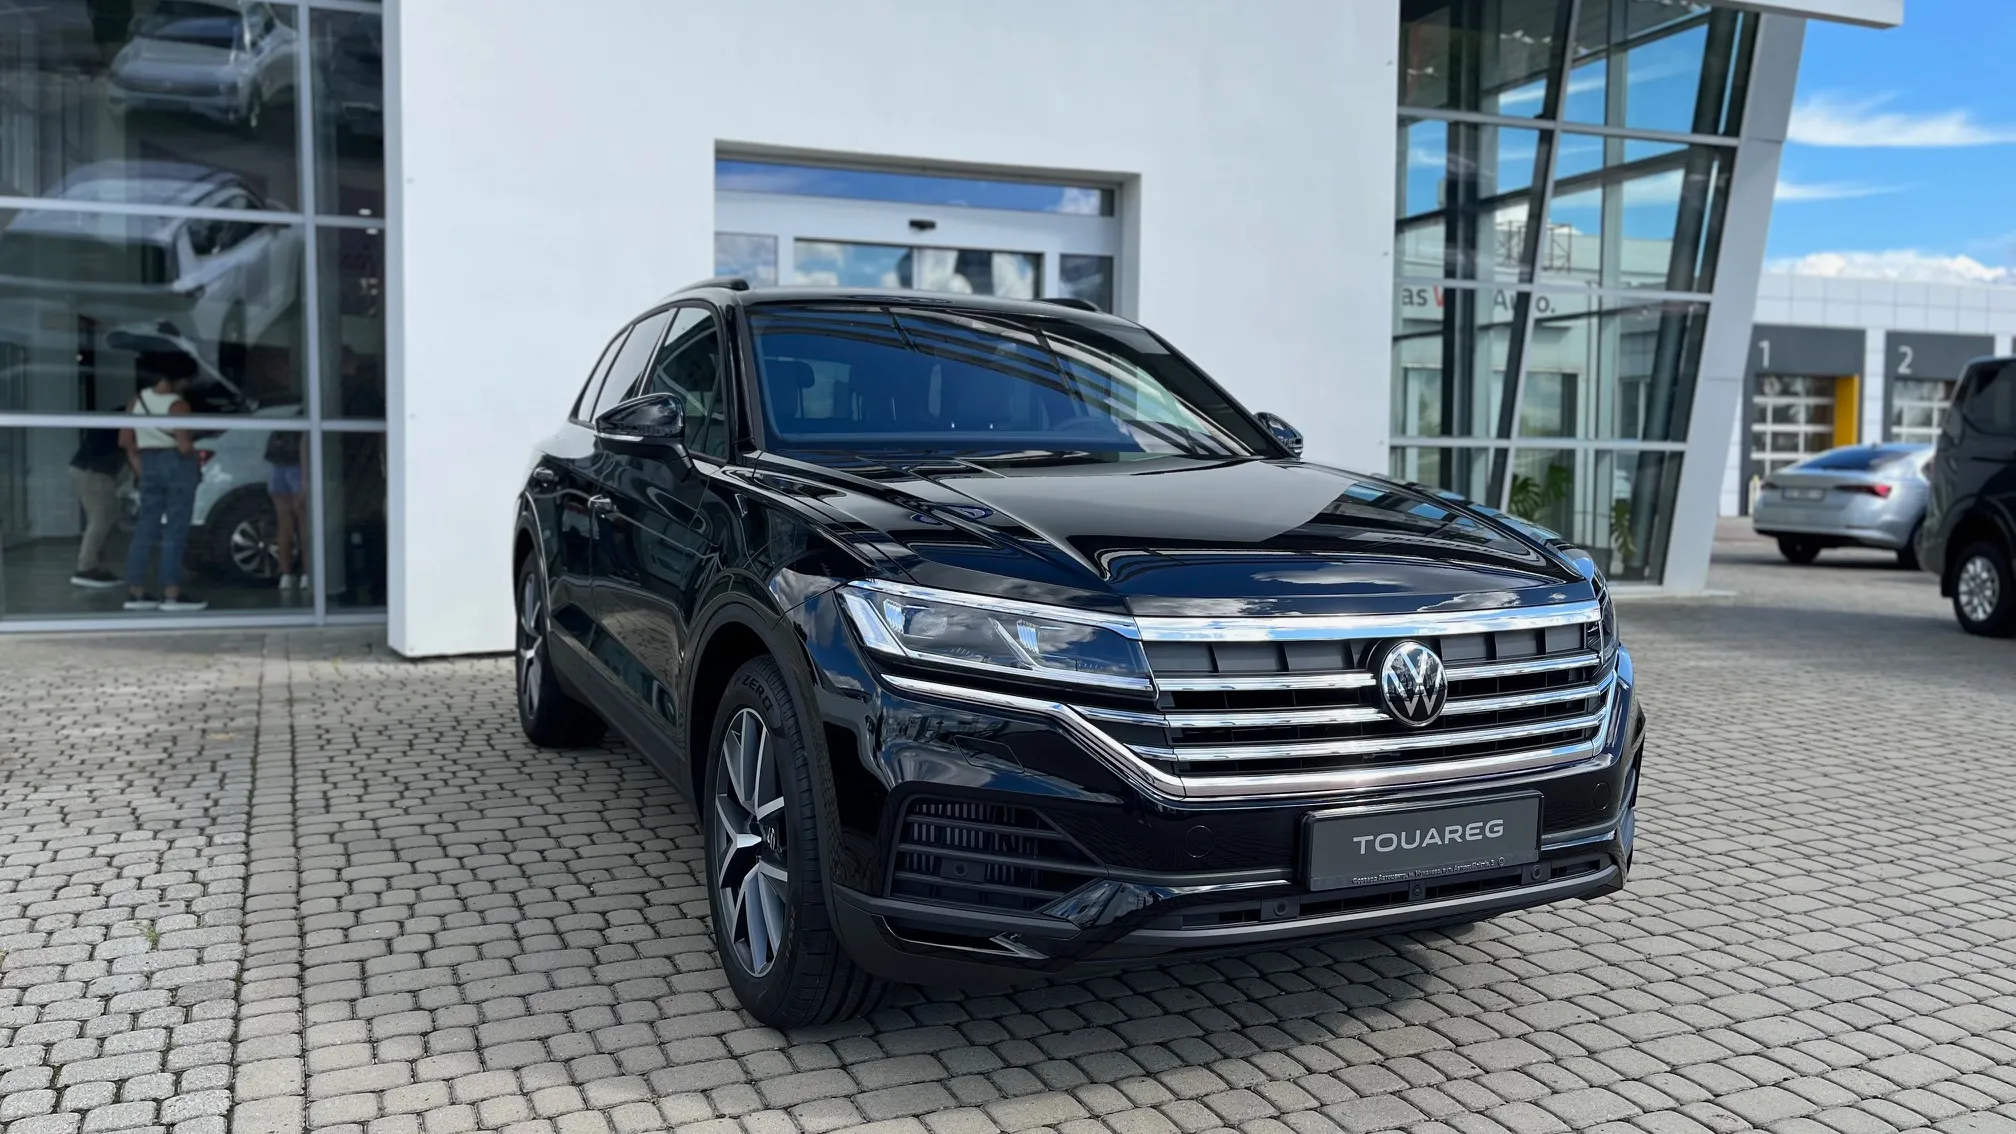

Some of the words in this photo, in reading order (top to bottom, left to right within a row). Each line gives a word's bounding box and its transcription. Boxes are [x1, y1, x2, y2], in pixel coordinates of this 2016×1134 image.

[1758, 340, 1770, 368] 1
[1897, 345, 1914, 374] 2
[1353, 819, 1504, 854] TOUAREG
